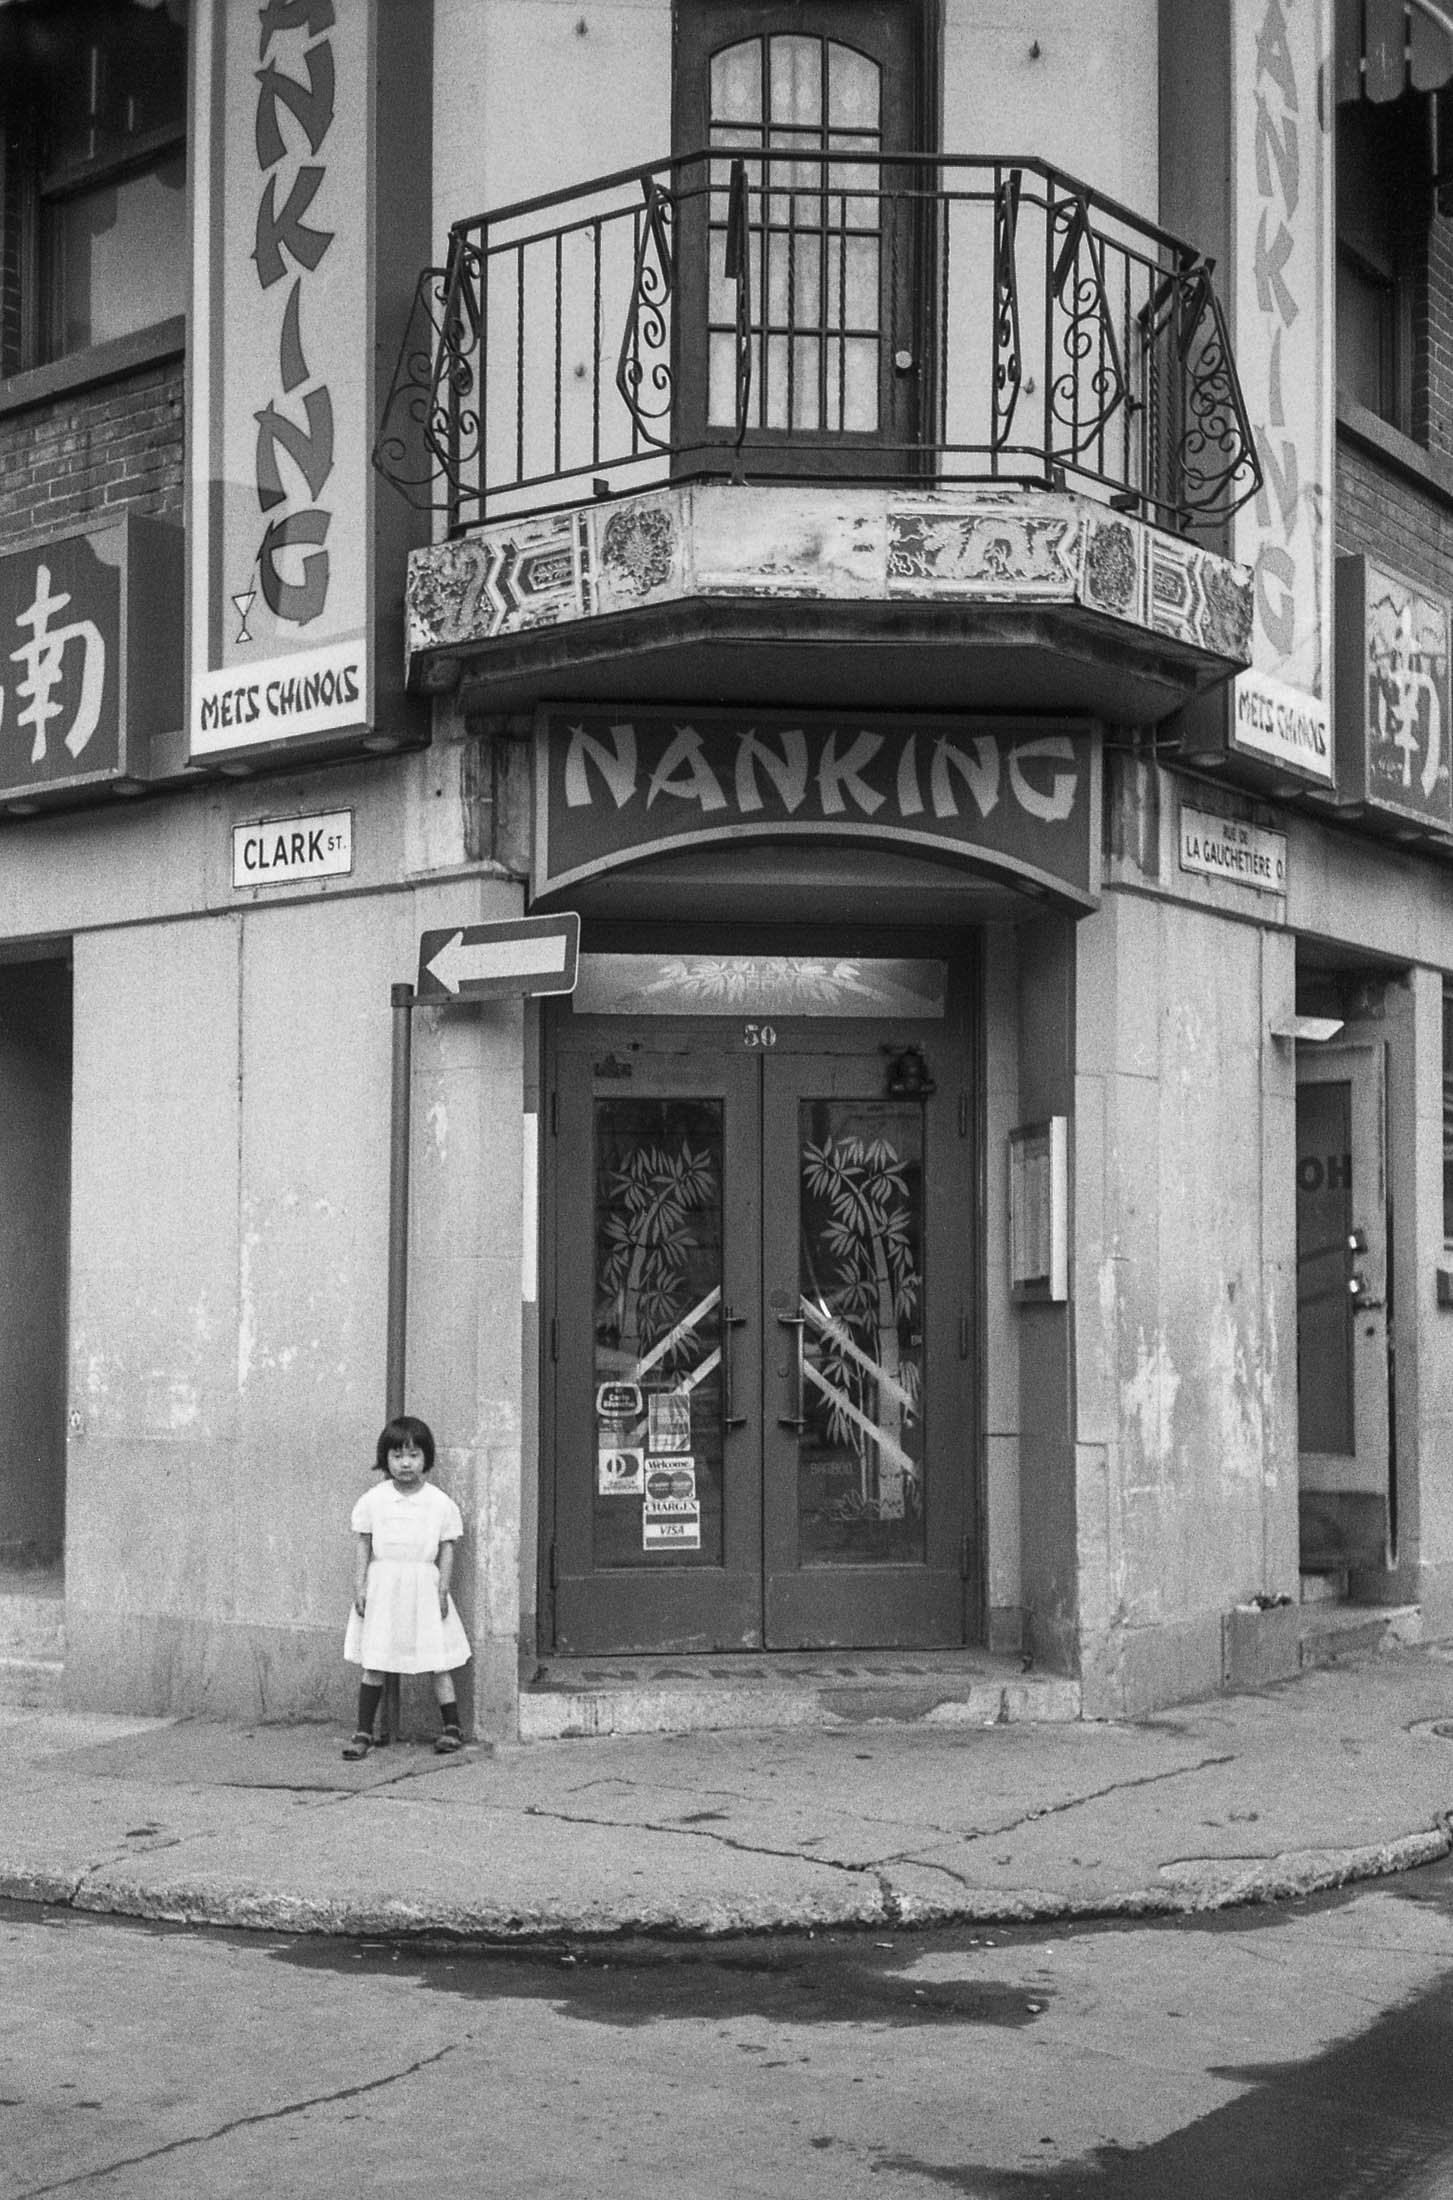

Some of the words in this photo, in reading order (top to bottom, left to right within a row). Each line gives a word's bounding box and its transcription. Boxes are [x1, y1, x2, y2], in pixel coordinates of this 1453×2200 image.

[200, 685, 261, 731] METS
[266, 665, 360, 717] CHINOIS
[1239, 690, 1274, 734] METS
[1277, 703, 1327, 757] CHINOIS
[564, 722, 1079, 823] NANKING
[1186, 835, 1200, 858] LA
[1222, 823, 1237, 842] RUE
[1238, 828, 1249, 846] DE
[243, 828, 325, 871] CLARK
[327, 834, 348, 852] ST.
[743, 1023, 777, 1047] 50
[644, 1502, 698, 1512] CHARGEX
[660, 1524, 685, 1536] VISA
